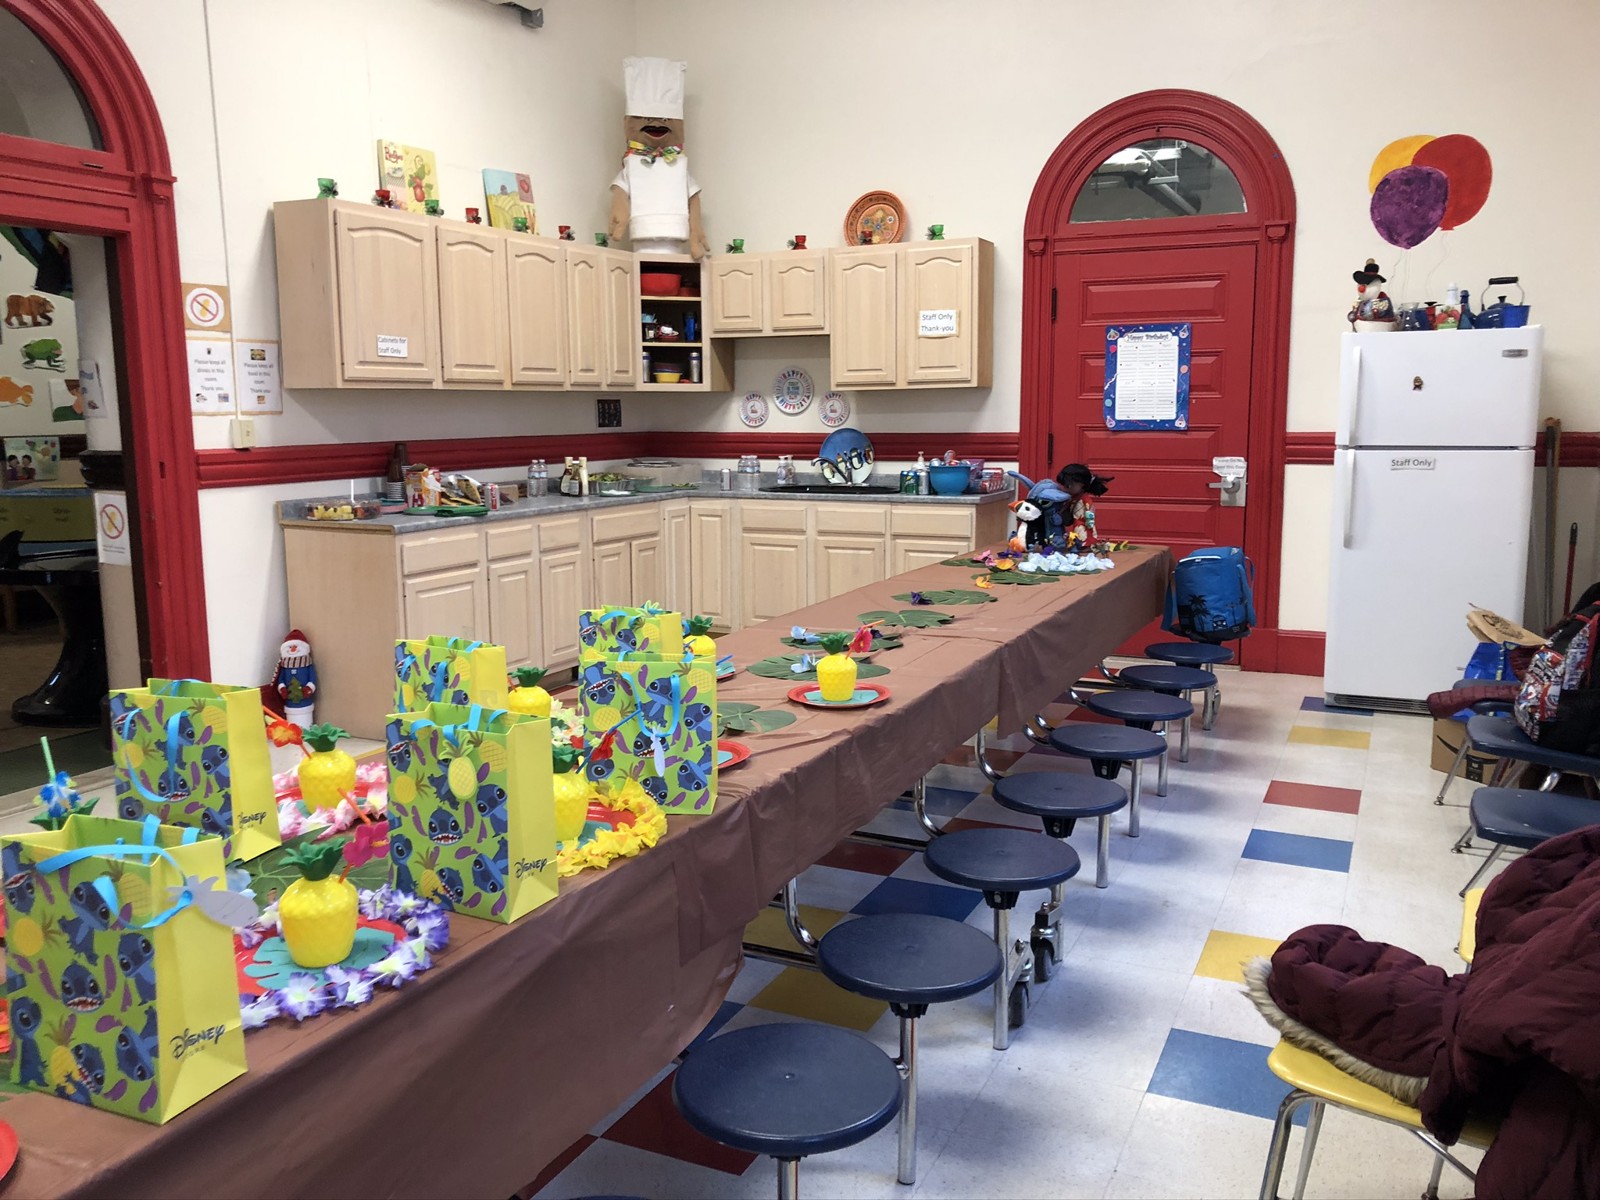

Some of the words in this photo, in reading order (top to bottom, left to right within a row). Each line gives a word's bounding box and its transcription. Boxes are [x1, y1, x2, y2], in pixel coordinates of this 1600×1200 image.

[922, 313, 937, 321] Staff
[938, 313, 953, 321] Only
[390, 347, 402, 355] Only
[1391, 459, 1411, 467] Staff
[1412, 458, 1433, 468] Only
